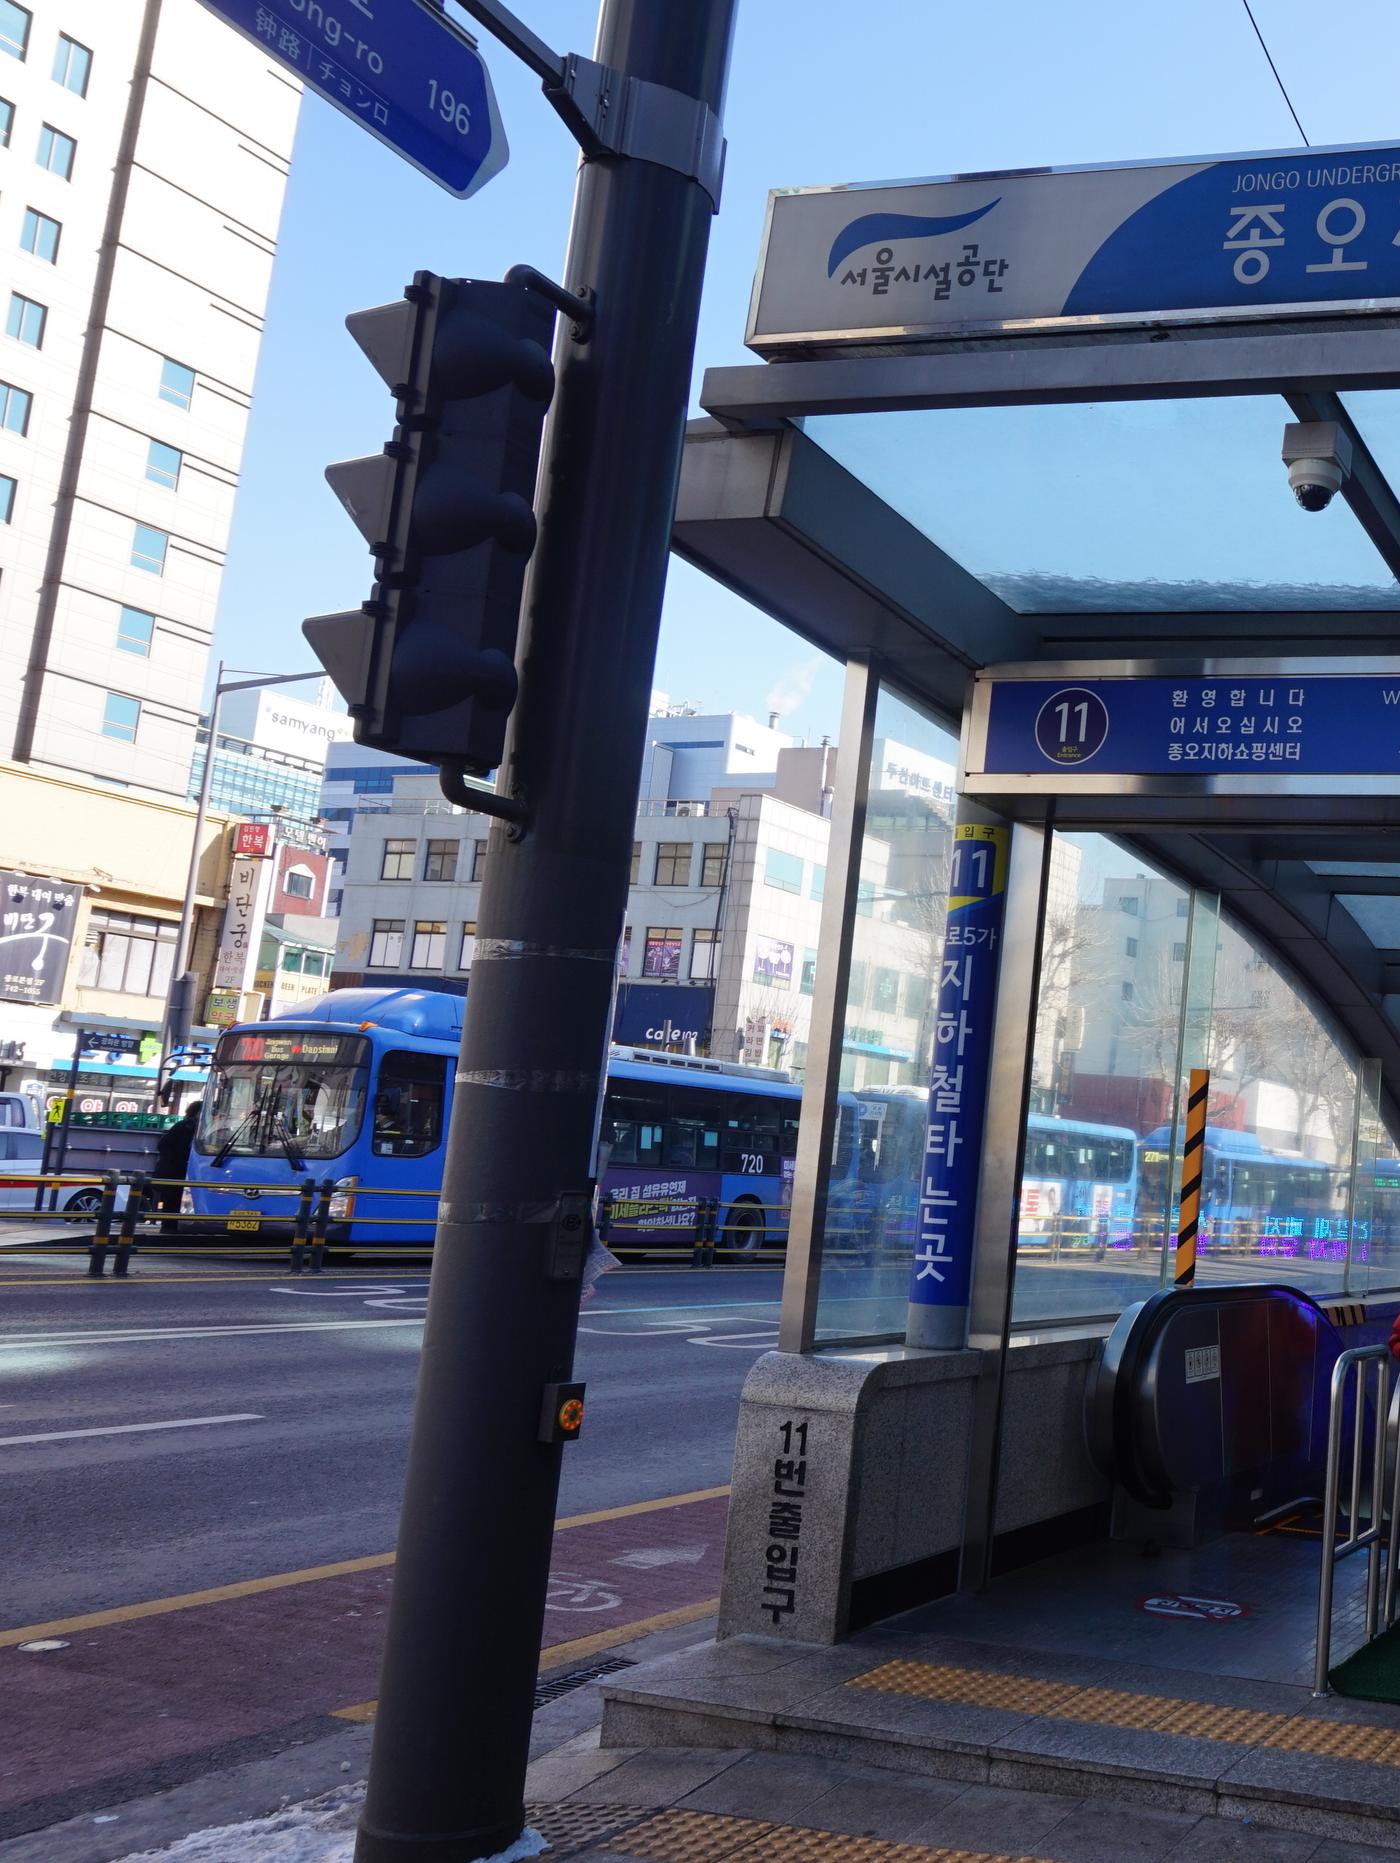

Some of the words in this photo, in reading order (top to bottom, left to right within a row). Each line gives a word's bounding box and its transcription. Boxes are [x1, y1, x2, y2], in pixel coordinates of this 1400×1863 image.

[255, 7, 302, 59] 钟路
[290, 0, 384, 74] ong-ro
[428, 79, 471, 135] 196
[1232, 172, 1300, 193] JONGO
[840, 244, 1010, 300] 서울시설공단
[271, 711, 336, 742] samyang
[1055, 702, 1088, 742] 11
[1167, 741, 1301, 762] 종오지하쇼핑센터
[944, 926, 997, 951] 로5가
[281, 982, 295, 991] BEER
[301, 986, 318, 996] PLATE
[741, 1154, 764, 1174] 720
[643, 1180, 687, 1198] 섬유유연제
